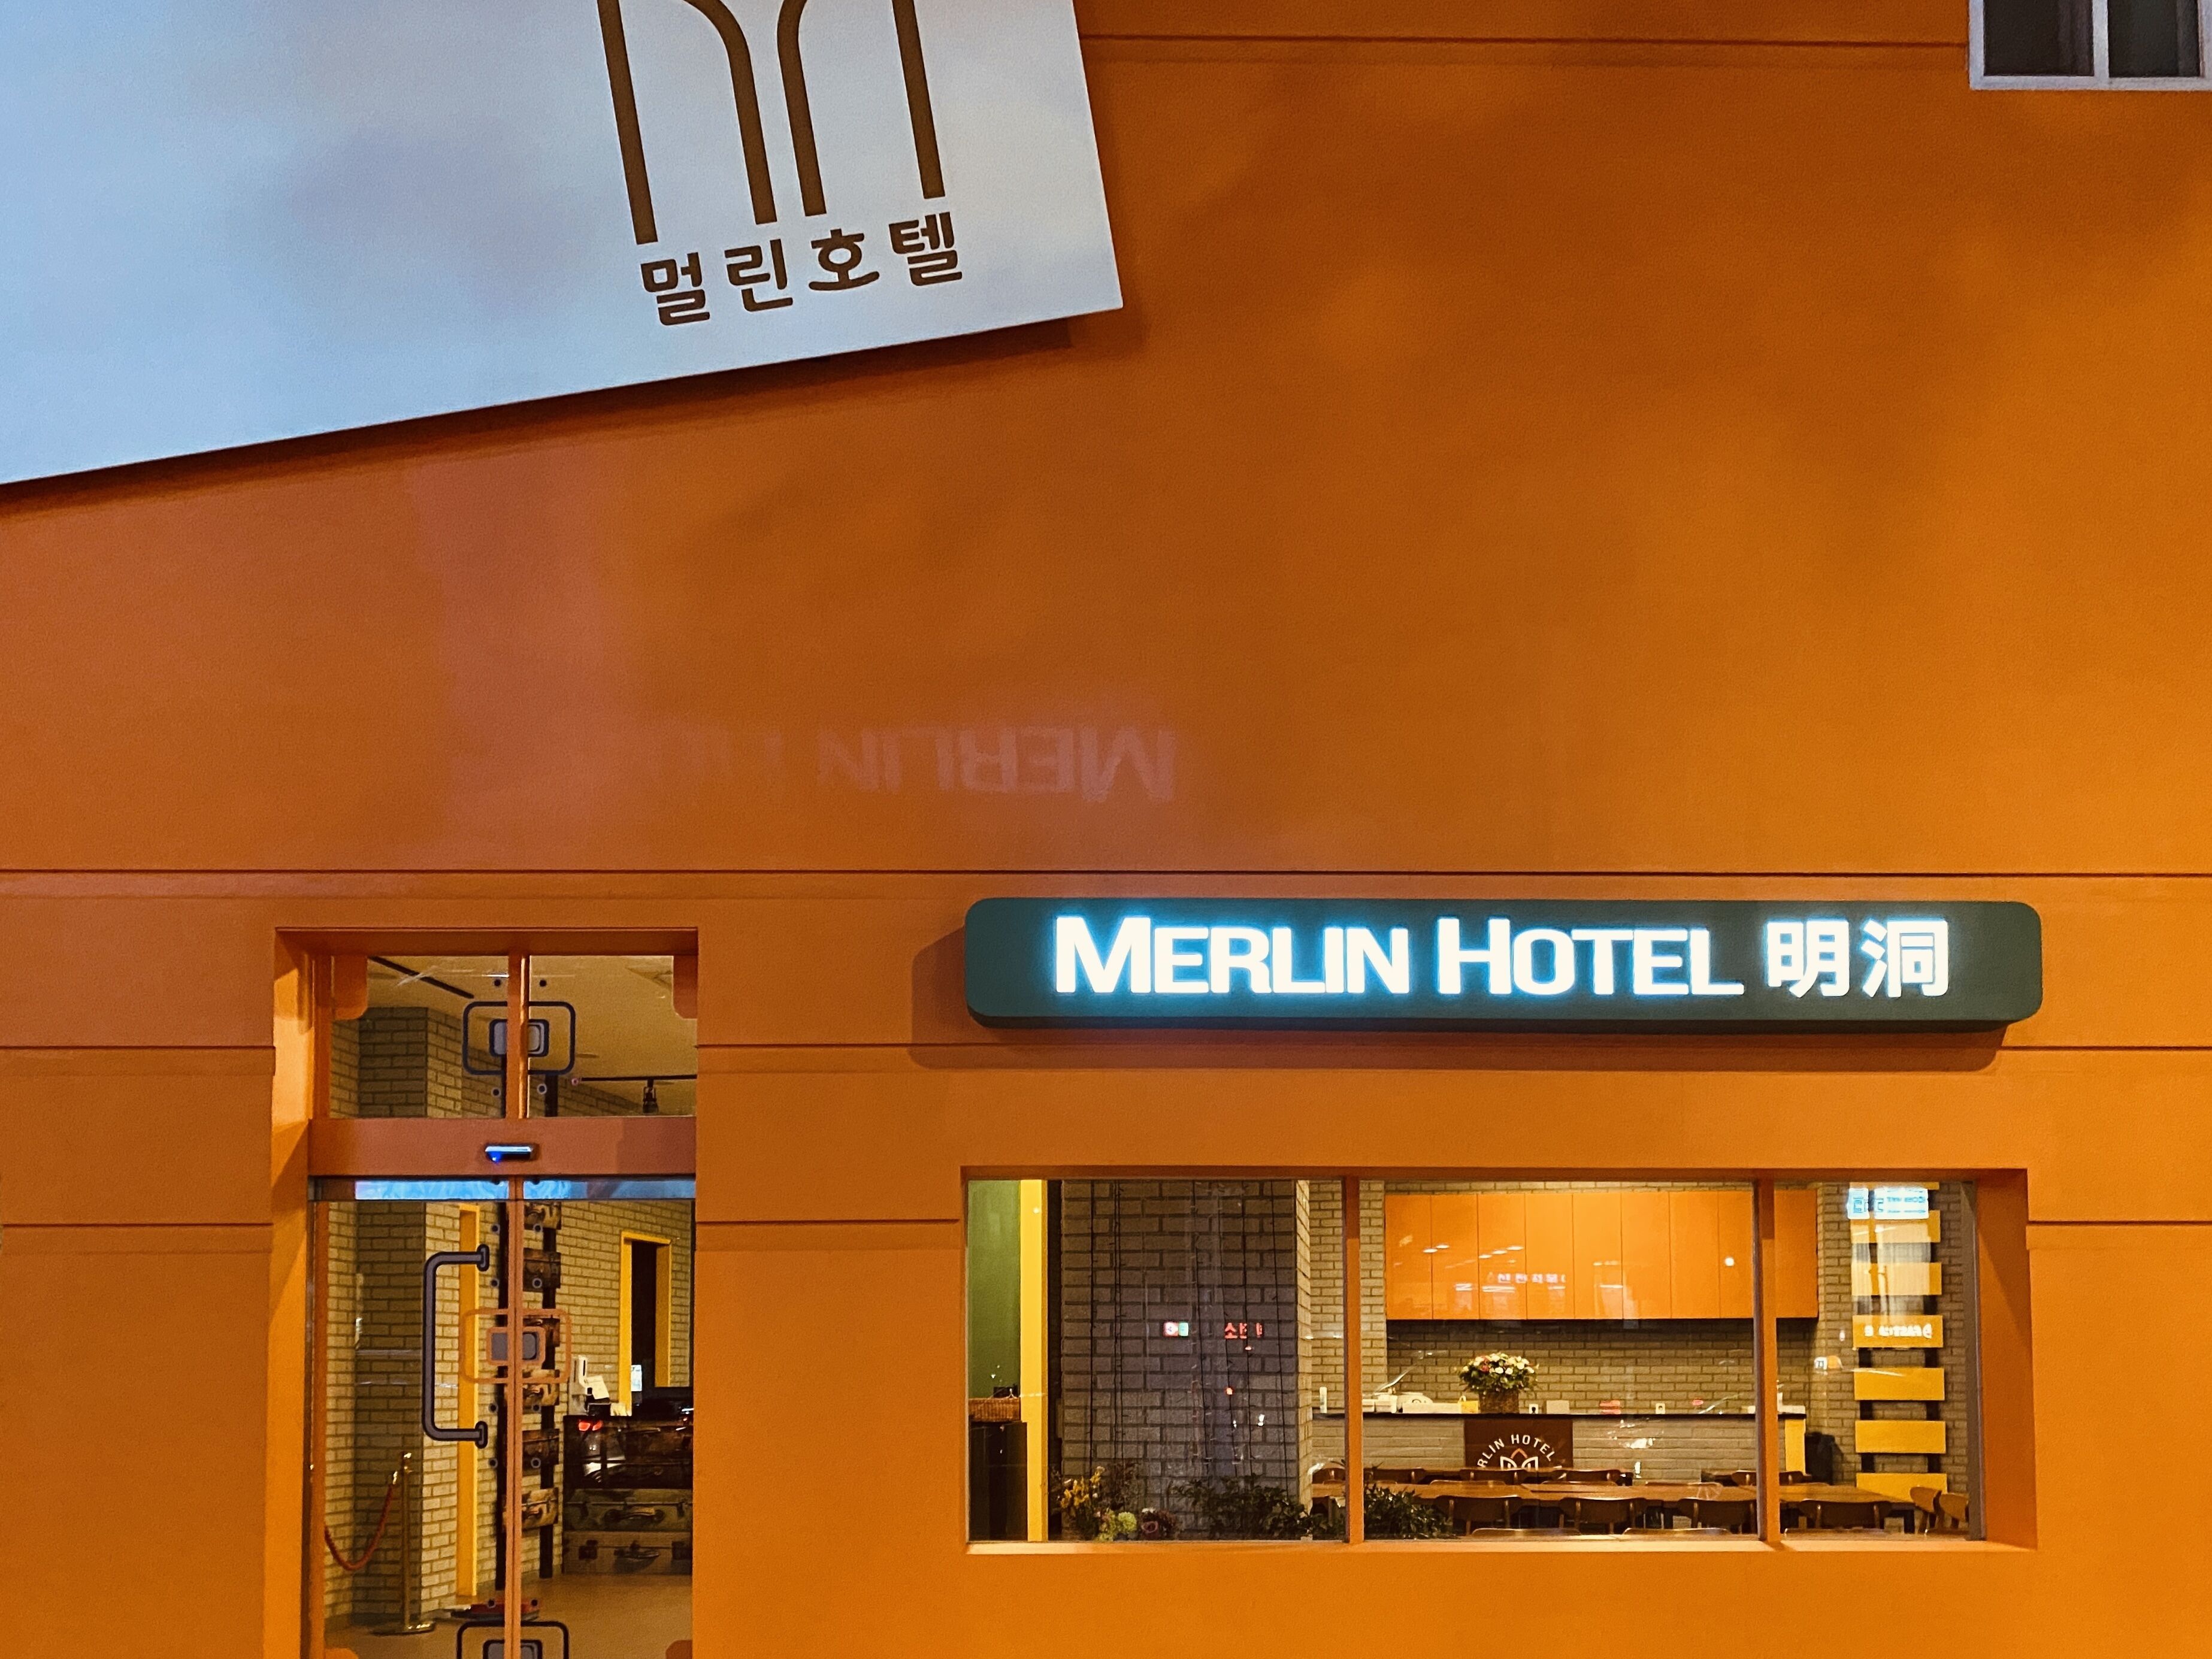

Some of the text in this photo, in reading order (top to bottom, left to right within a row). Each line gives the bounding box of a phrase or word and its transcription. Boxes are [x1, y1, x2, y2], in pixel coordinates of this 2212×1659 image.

[640, 212, 963, 326] 멀린호텔
[1056, 917, 1949, 998] MERLIN HOTEL 明洞
[1511, 1434, 1555, 1461] HOTEL
